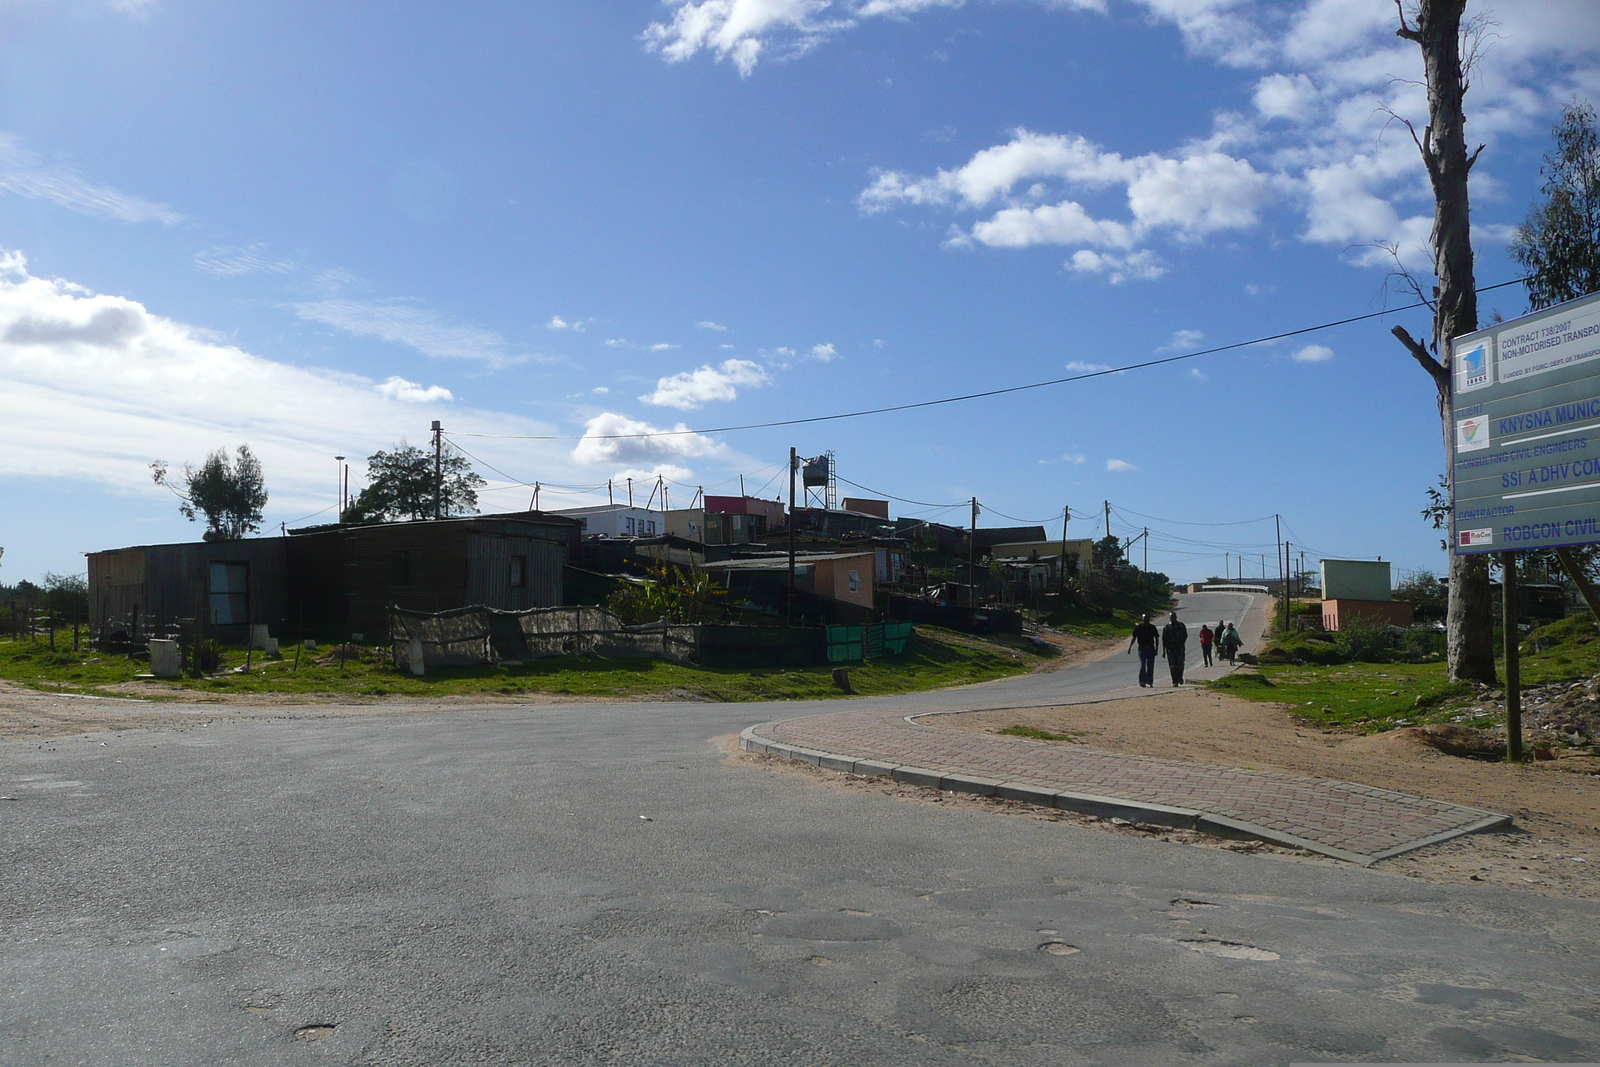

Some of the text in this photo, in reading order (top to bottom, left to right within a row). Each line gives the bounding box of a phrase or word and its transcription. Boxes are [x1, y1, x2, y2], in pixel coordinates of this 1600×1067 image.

[1502, 331, 1539, 349] CONTRACT
[1502, 324, 1600, 361] NON-MOTORISED TRANSPO
[1503, 369, 1522, 380] FUNDED
[1574, 348, 1600, 361] TRANSPO
[1457, 403, 1483, 418] CLIENT
[1500, 409, 1552, 434] KNYSNA
[1458, 437, 1587, 470] CONSULTING CIVIL ENGINEERS
[1502, 470, 1522, 488] SSI
[1528, 468, 1538, 484] A
[1541, 462, 1569, 482] DHV
[1458, 505, 1515, 522] CONTRACTOR
[1504, 522, 1561, 542] ROBCON
